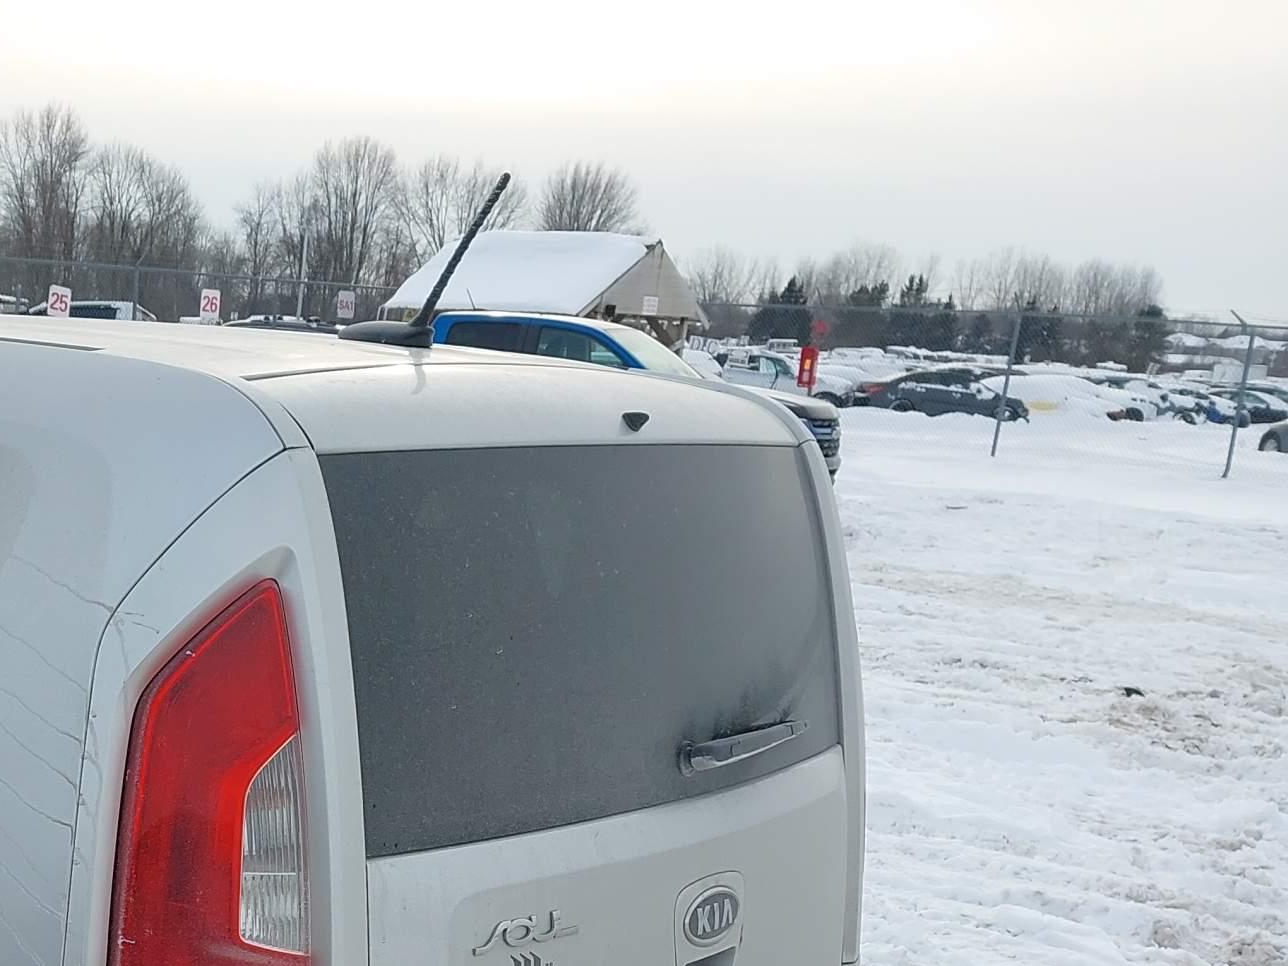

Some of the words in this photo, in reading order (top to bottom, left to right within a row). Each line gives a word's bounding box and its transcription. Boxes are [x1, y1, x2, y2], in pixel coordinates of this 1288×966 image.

[49, 292, 69, 312] 25
[202, 295, 218, 313] 26
[696, 898, 733, 937] KIA
